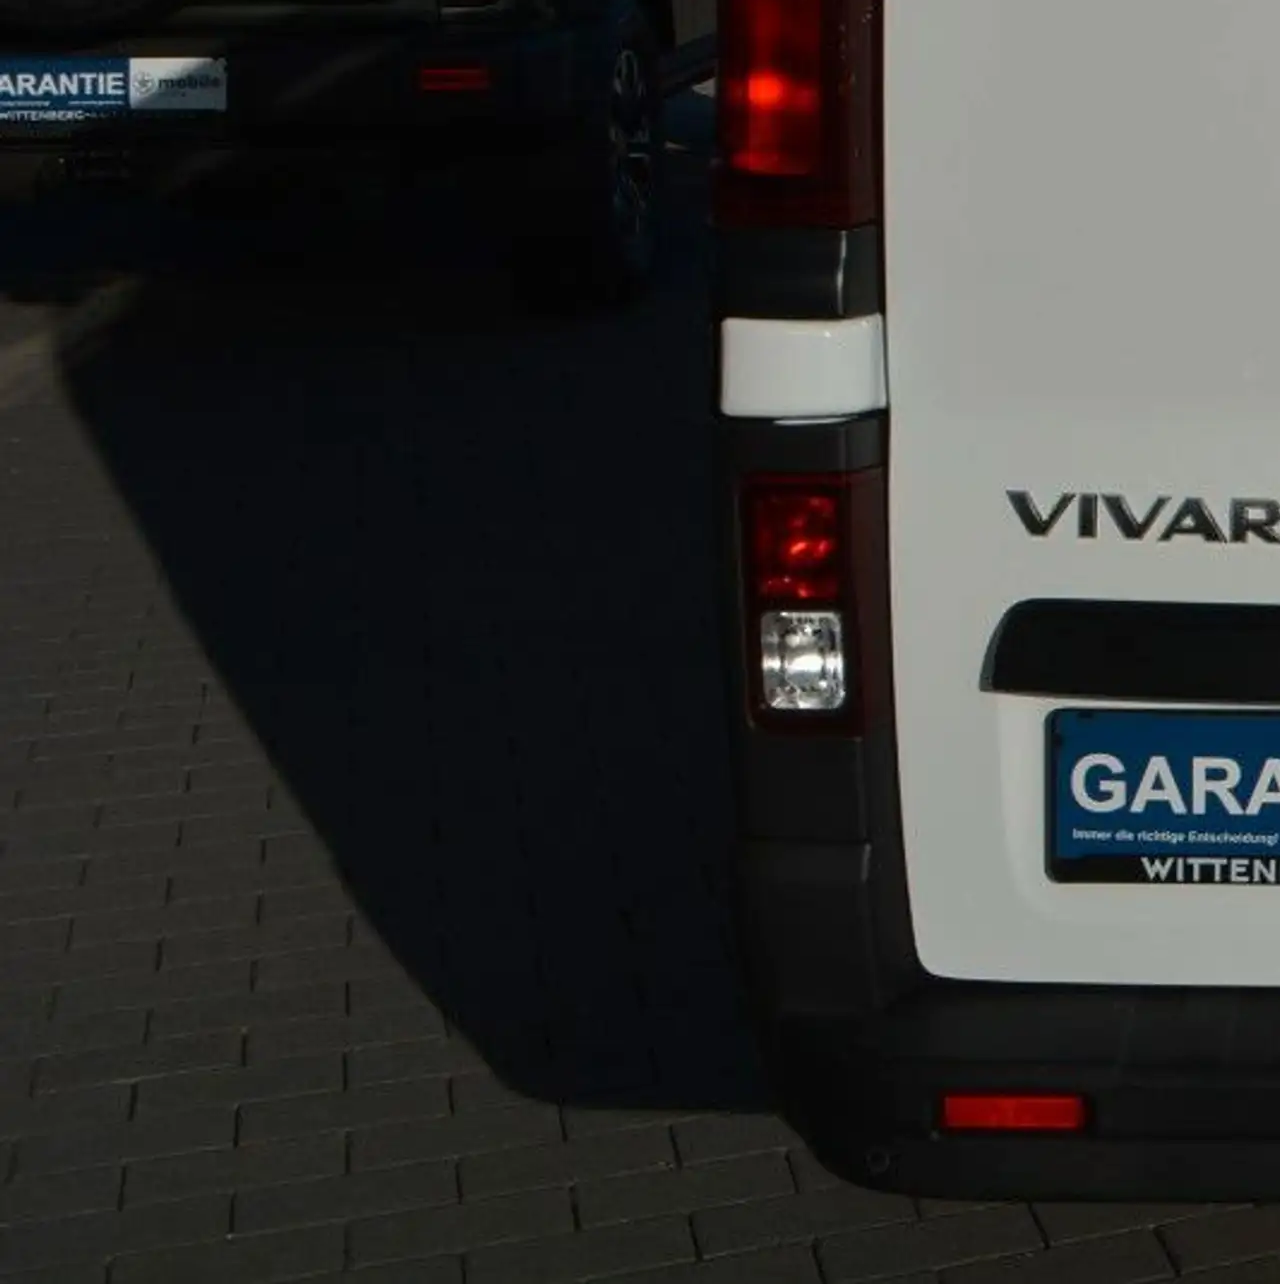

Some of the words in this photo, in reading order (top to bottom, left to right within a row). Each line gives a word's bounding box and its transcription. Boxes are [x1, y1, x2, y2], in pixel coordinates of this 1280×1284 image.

[1072, 827, 1112, 841] Immer
[1115, 829, 1134, 842] die
[1137, 828, 1186, 845] richtige
